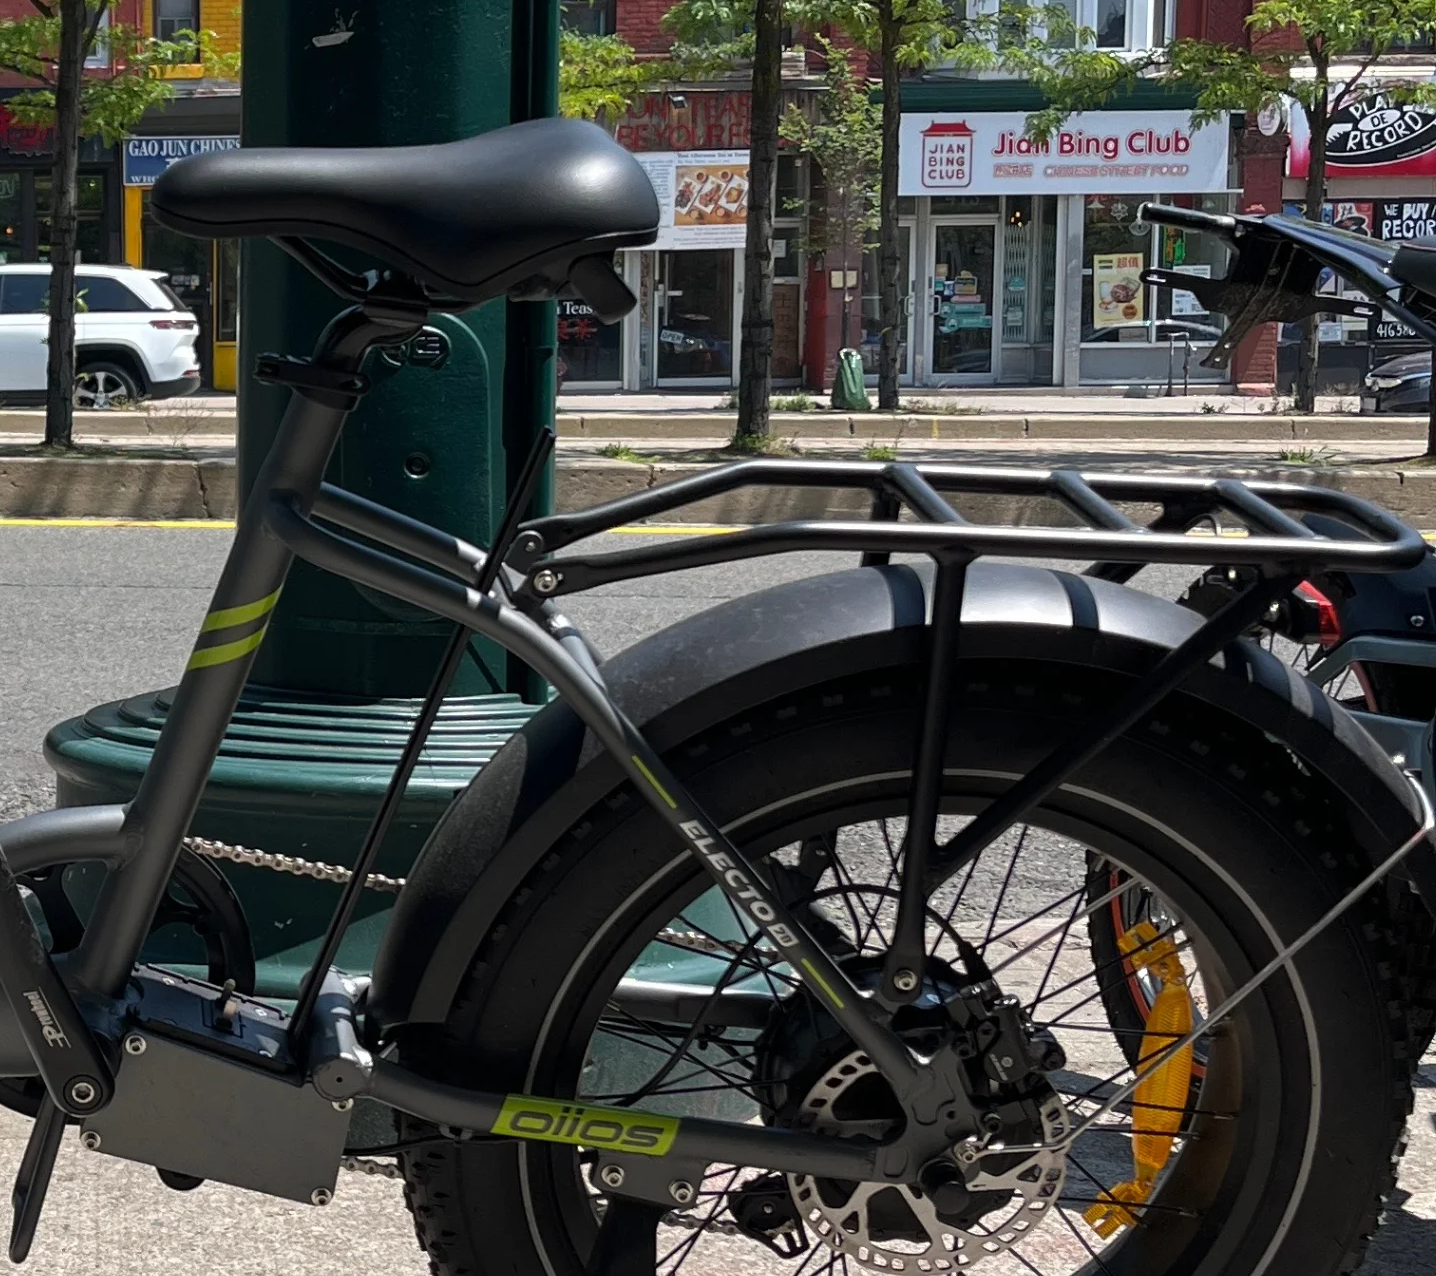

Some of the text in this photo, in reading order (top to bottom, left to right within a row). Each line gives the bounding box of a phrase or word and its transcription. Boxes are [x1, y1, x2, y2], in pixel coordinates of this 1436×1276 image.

[1370, 112, 1388, 128] DE
[1346, 111, 1423, 152] RECORD
[128, 139, 159, 157] GAO
[160, 139, 188, 157] JUN
[929, 143, 966, 154] JIAN
[1058, 131, 1120, 160] Bing
[1126, 128, 1192, 156] Club
[928, 156, 965, 167] BING
[928, 169, 965, 180] CLUB
[1384, 203, 1430, 221] WE BUY
[563, 302, 594, 315] Teas
[679, 820, 776, 922] ELECTO
[510, 1106, 664, 1148] oiios
